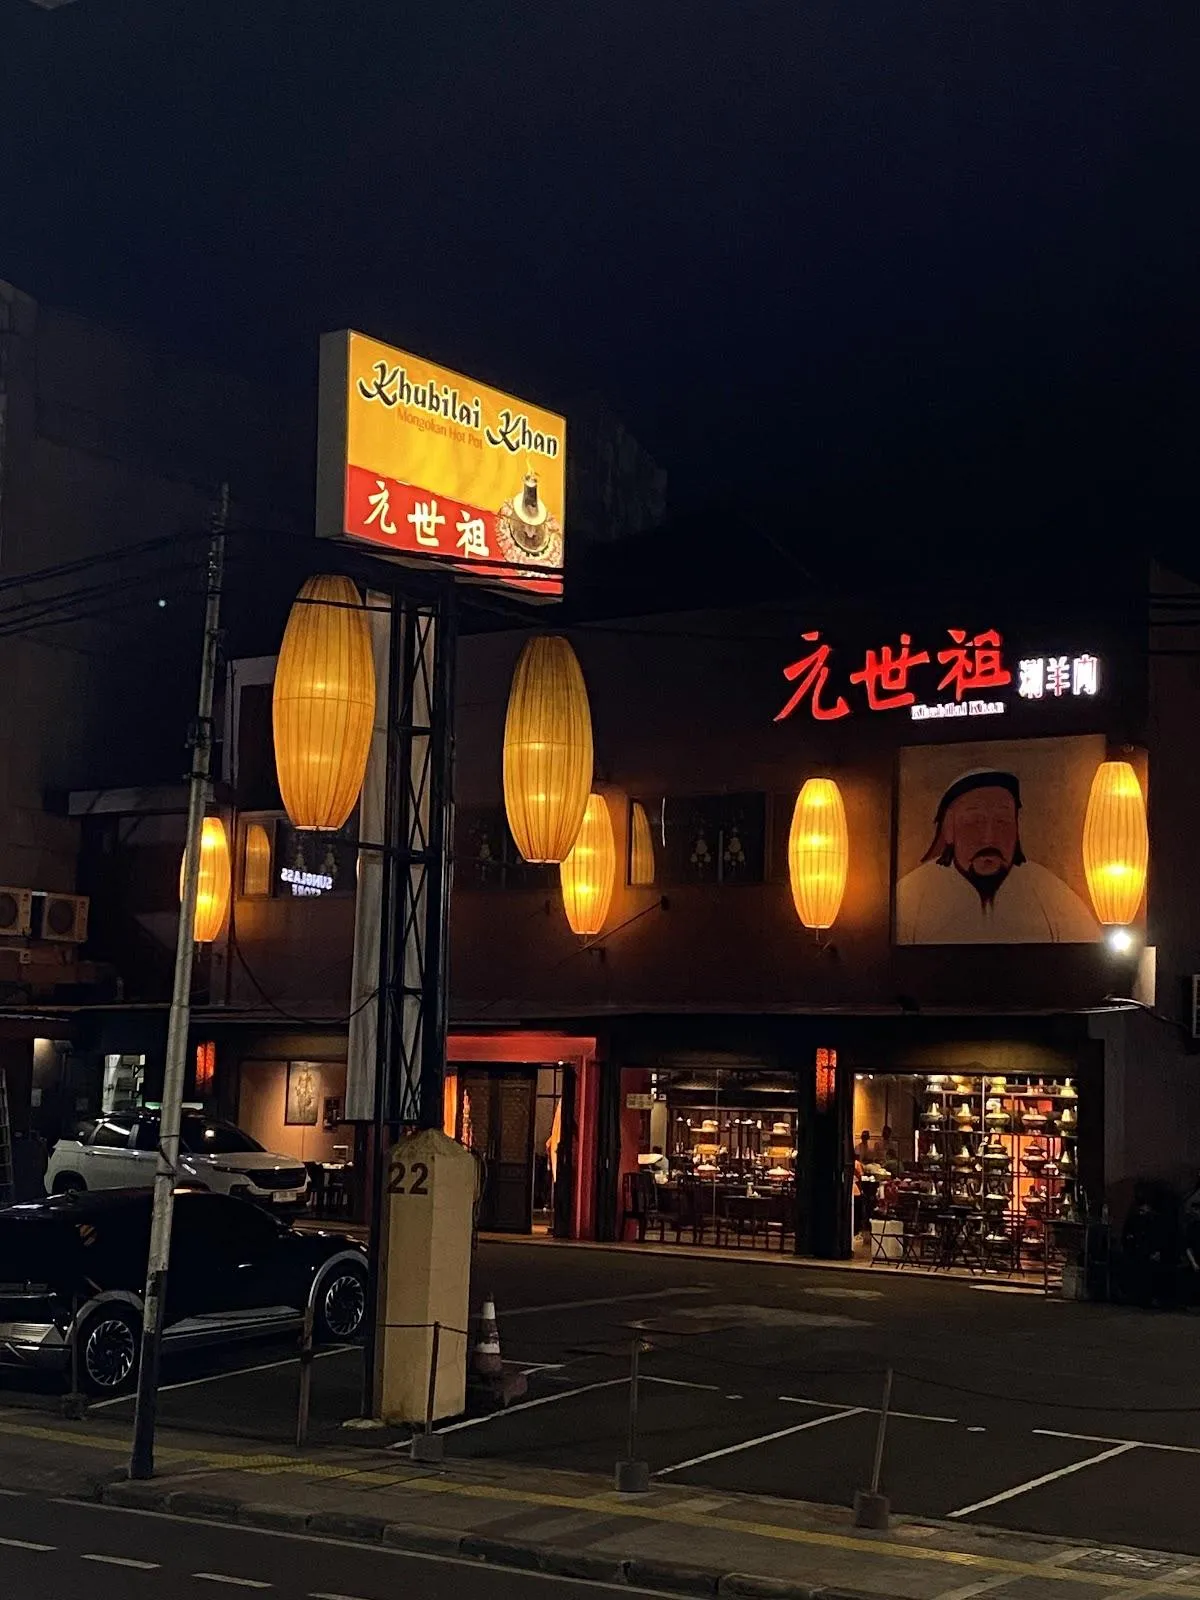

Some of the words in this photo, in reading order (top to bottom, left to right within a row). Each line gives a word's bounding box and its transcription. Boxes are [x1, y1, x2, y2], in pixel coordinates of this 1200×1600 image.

[358, 362, 480, 429] Khubilai
[486, 411, 558, 456] Khan
[449, 425, 466, 444] Hot
[468, 432, 483, 450] Pot
[364, 480, 490, 559] 元世祖
[773, 629, 1012, 722] 元世祖
[386, 1162, 428, 1195] 22
